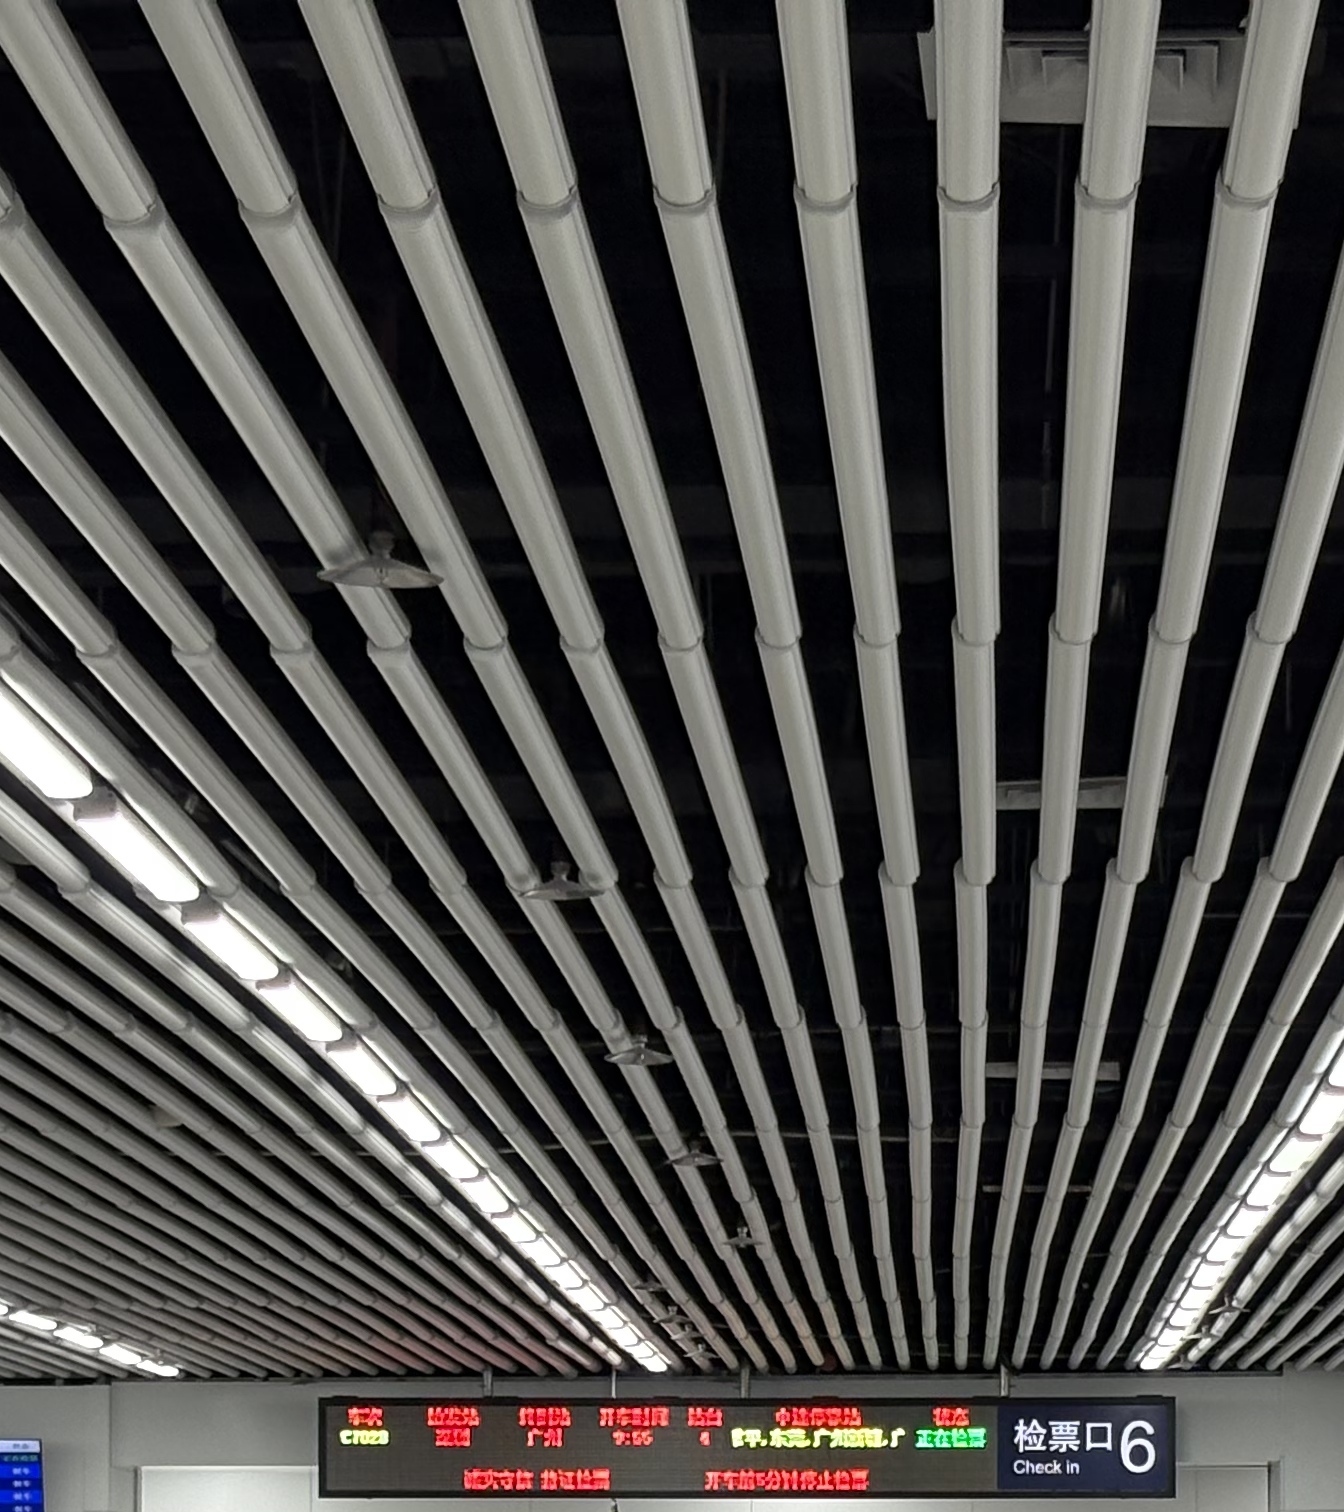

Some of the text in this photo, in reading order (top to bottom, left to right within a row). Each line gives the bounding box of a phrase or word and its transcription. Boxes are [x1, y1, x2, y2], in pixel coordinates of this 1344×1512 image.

[1013, 1419, 1113, 1452] 检票口
[1120, 1420, 1156, 1473] 6
[1013, 1459, 1080, 1475] Check in
